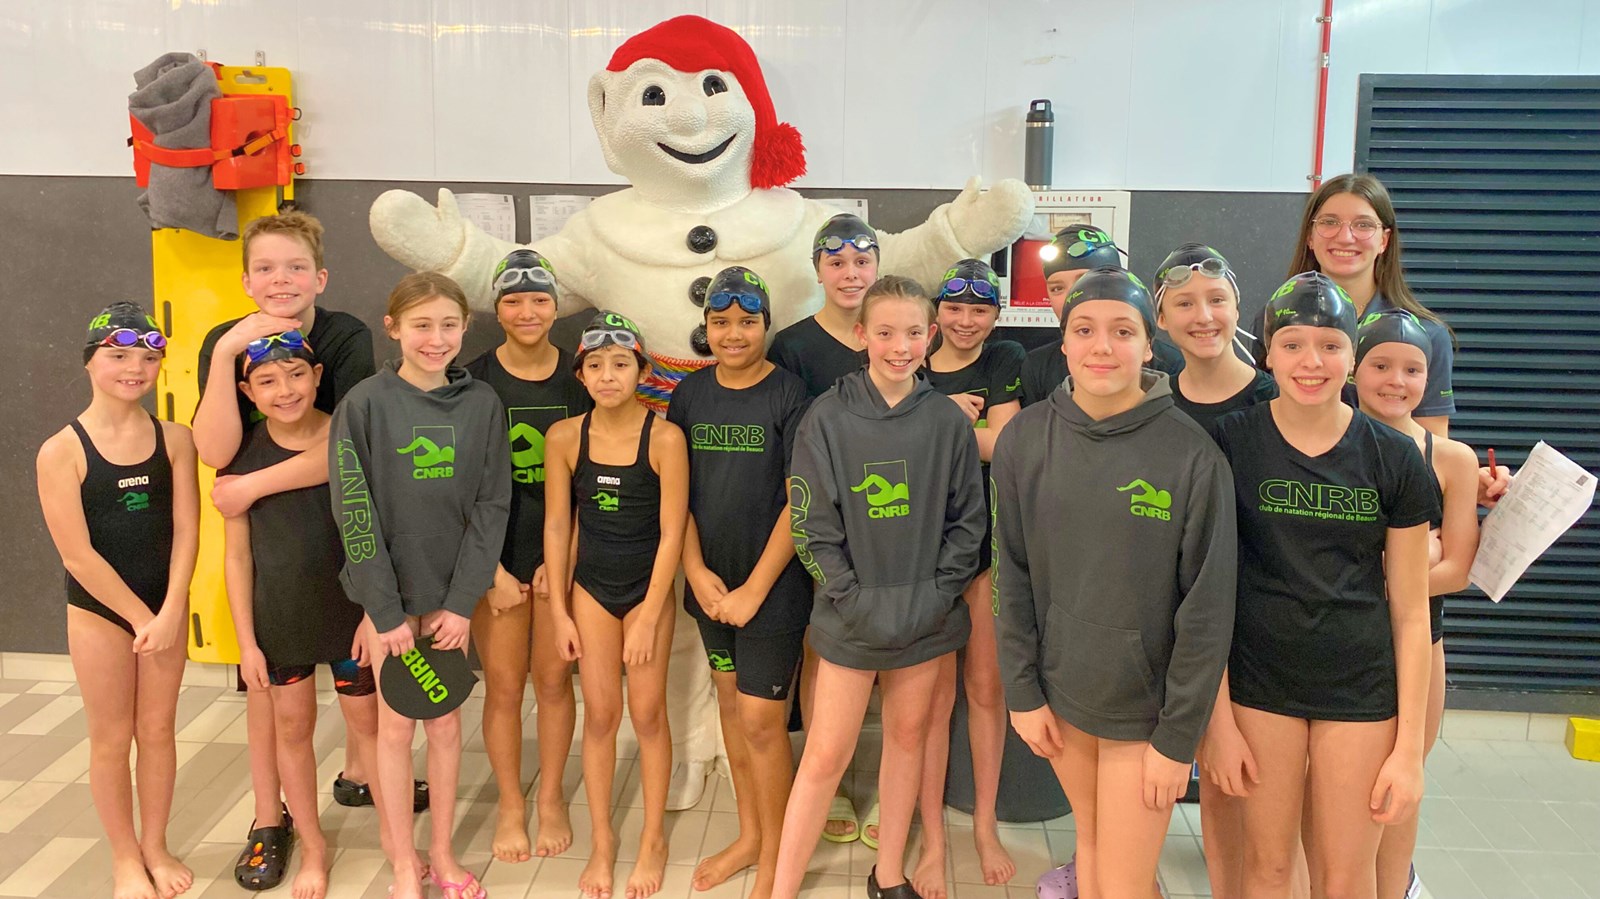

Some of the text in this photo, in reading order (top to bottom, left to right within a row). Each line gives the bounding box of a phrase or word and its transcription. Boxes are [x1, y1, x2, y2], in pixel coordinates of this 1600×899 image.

[690, 423, 765, 446] CNRB
[412, 466, 454, 480] CNRB
[597, 475, 621, 486] arena
[118, 475, 149, 489] arena
[342, 438, 376, 564] CNRB
[1258, 479, 1379, 514] CNRB
[868, 504, 910, 519] CNRB
[1130, 504, 1171, 521] CNRB
[1258, 504, 1273, 512] club
[1274, 505, 1283, 513] de
[1284, 507, 1314, 517] natation
[1314, 510, 1345, 520] régional
[1345, 513, 1355, 521] de
[401, 647, 449, 704] CNRB
